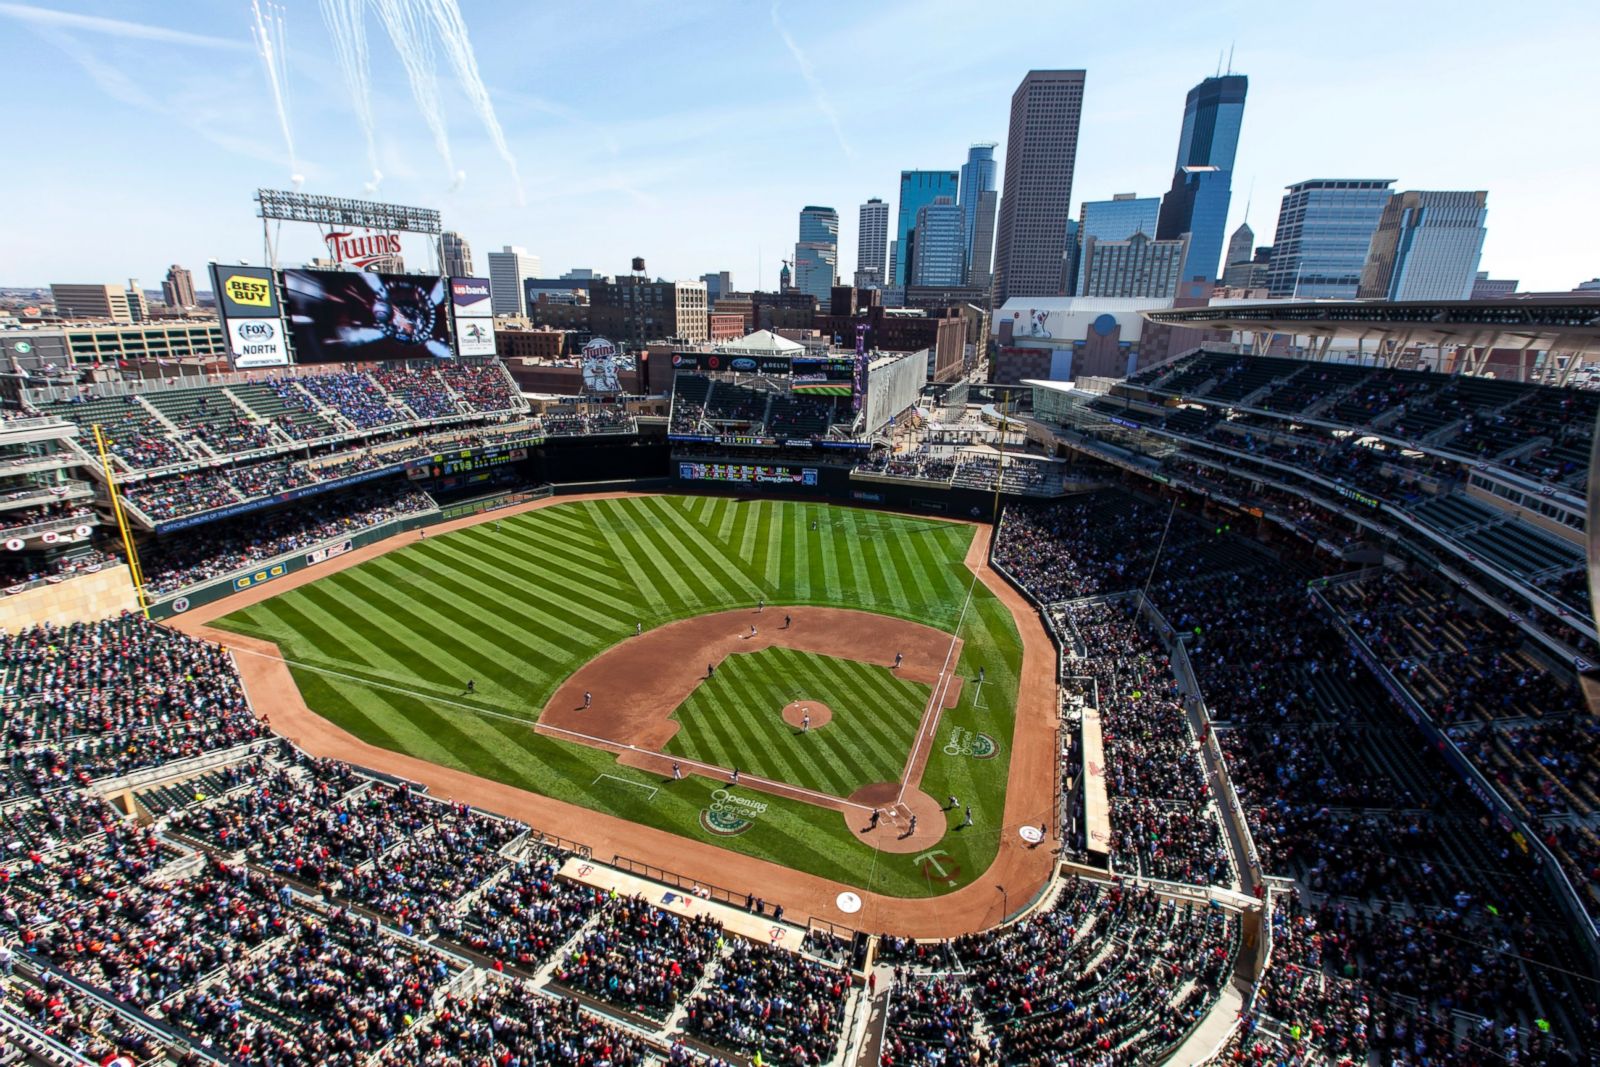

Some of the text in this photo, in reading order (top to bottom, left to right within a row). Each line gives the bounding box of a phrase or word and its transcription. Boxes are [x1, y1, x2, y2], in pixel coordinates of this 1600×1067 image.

[325, 228, 401, 263] Twins
[231, 281, 268, 293] BEST
[234, 291, 266, 301] BUY
[245, 324, 266, 334] FOX
[243, 344, 277, 355] NORTH
[582, 345, 615, 359] Twins
[162, 521, 188, 531] OFFICIAL
[189, 515, 209, 524] AIRLINE
[229, 503, 257, 514] MINNESOTA
[258, 499, 274, 507] TWINS
[711, 789, 768, 813] Opening
[710, 802, 757, 818] Series
